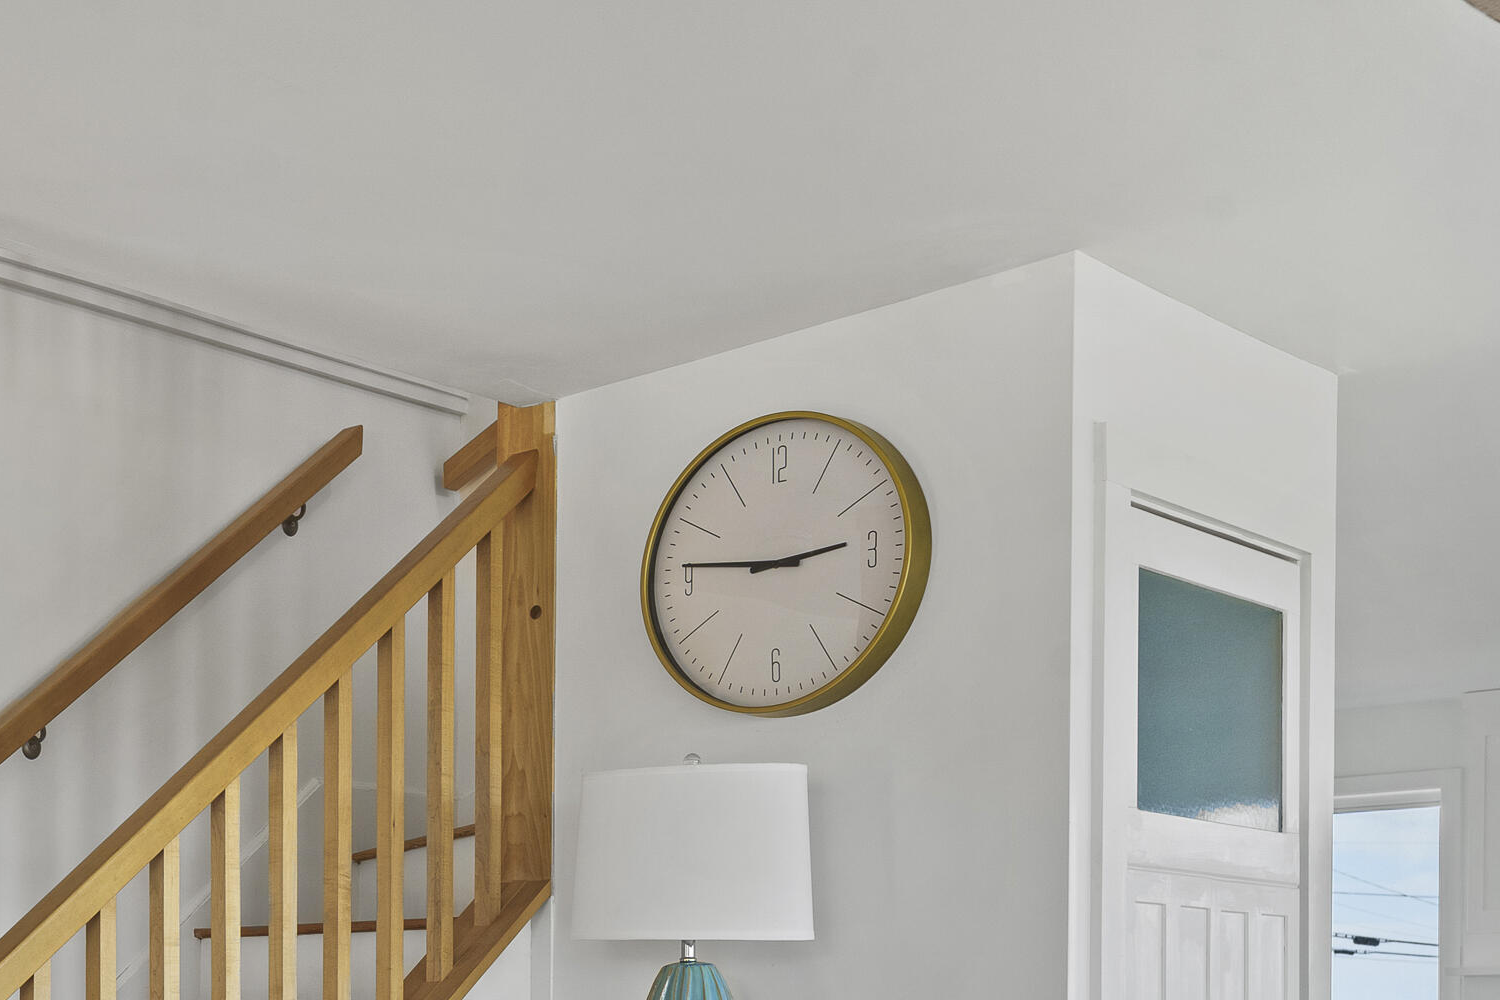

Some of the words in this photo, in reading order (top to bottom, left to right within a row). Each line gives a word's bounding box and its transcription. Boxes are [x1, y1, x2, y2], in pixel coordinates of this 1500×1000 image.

[771, 445, 788, 484] 12
[867, 530, 878, 568] 3
[770, 648, 781, 683] 6
